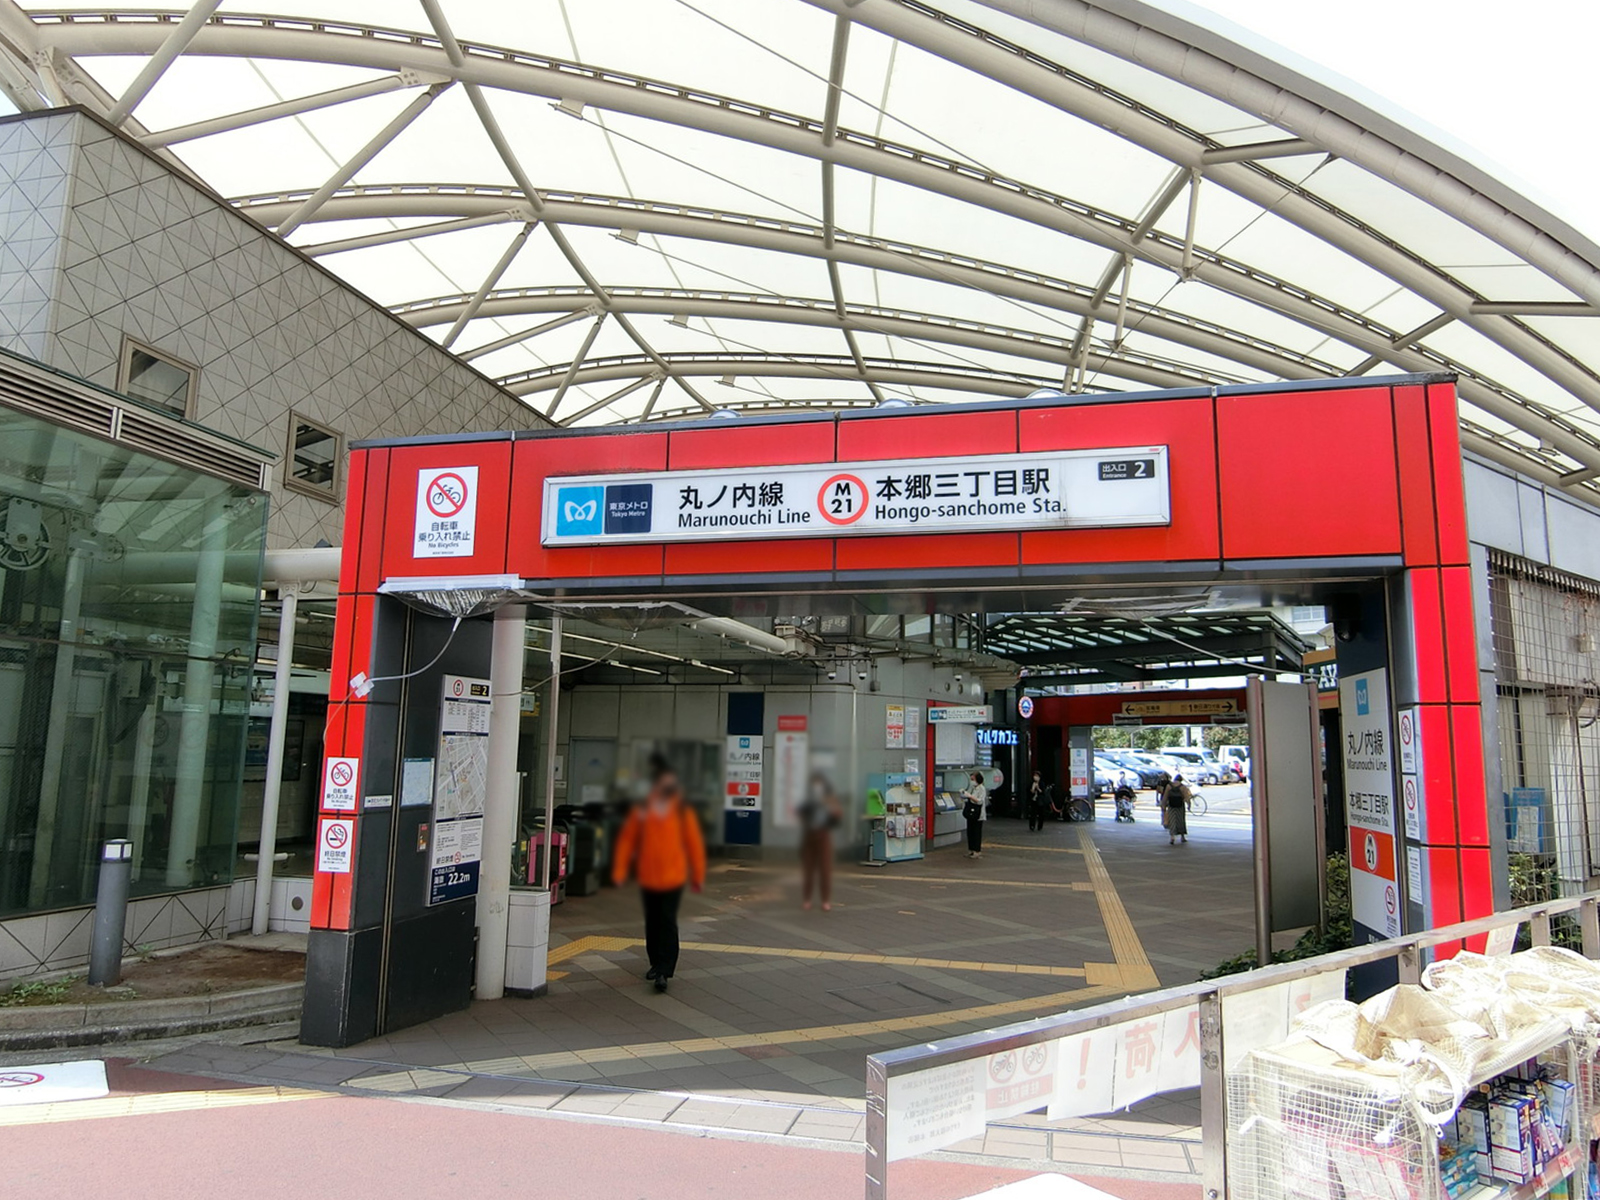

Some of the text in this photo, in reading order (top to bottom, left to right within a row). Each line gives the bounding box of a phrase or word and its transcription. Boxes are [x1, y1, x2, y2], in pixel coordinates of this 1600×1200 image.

[1102, 463, 1127, 473] 出入口
[1134, 461, 1147, 477] 2
[834, 482, 851, 496] M
[875, 468, 1050, 502] 本郷三丁目駅
[679, 481, 784, 510] 丸ノ内線
[609, 500, 648, 511] 東京メトロ
[831, 499, 852, 514] 21
[875, 498, 1066, 523] Hongo-sanchome Sta.
[678, 508, 811, 528] Marunouchi Line
[431, 521, 458, 532] 自転車
[418, 530, 470, 542] 乗り入れ禁止
[438, 542, 459, 550] Bicycles
[482, 686, 488, 696] 2
[1348, 728, 1384, 756] 丸ノ内線
[1347, 757, 1387, 771] Marunouchi Line
[1350, 790, 1390, 816] 本郷三丁目駅
[1367, 834, 1374, 847] M
[1367, 850, 1375, 865] 21
[448, 872, 471, 886] 22.2m
